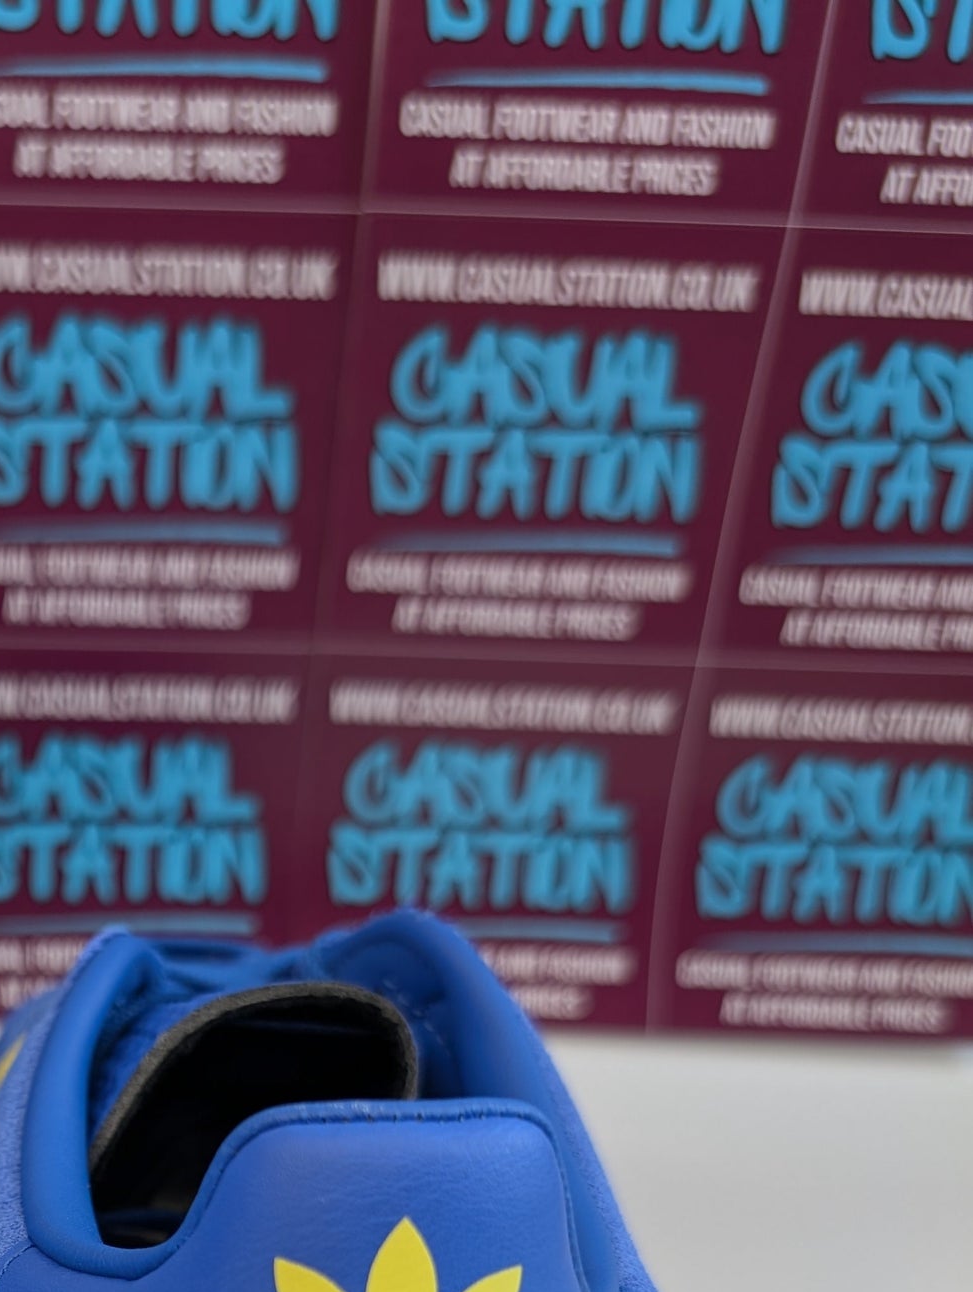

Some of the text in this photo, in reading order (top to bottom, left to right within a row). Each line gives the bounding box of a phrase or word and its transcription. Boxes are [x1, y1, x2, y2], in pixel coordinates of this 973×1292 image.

[391, 324, 699, 431] CASUAL
[370, 421, 701, 520] STATION
[344, 738, 625, 830] CASUAL
[327, 821, 632, 911] STATION
